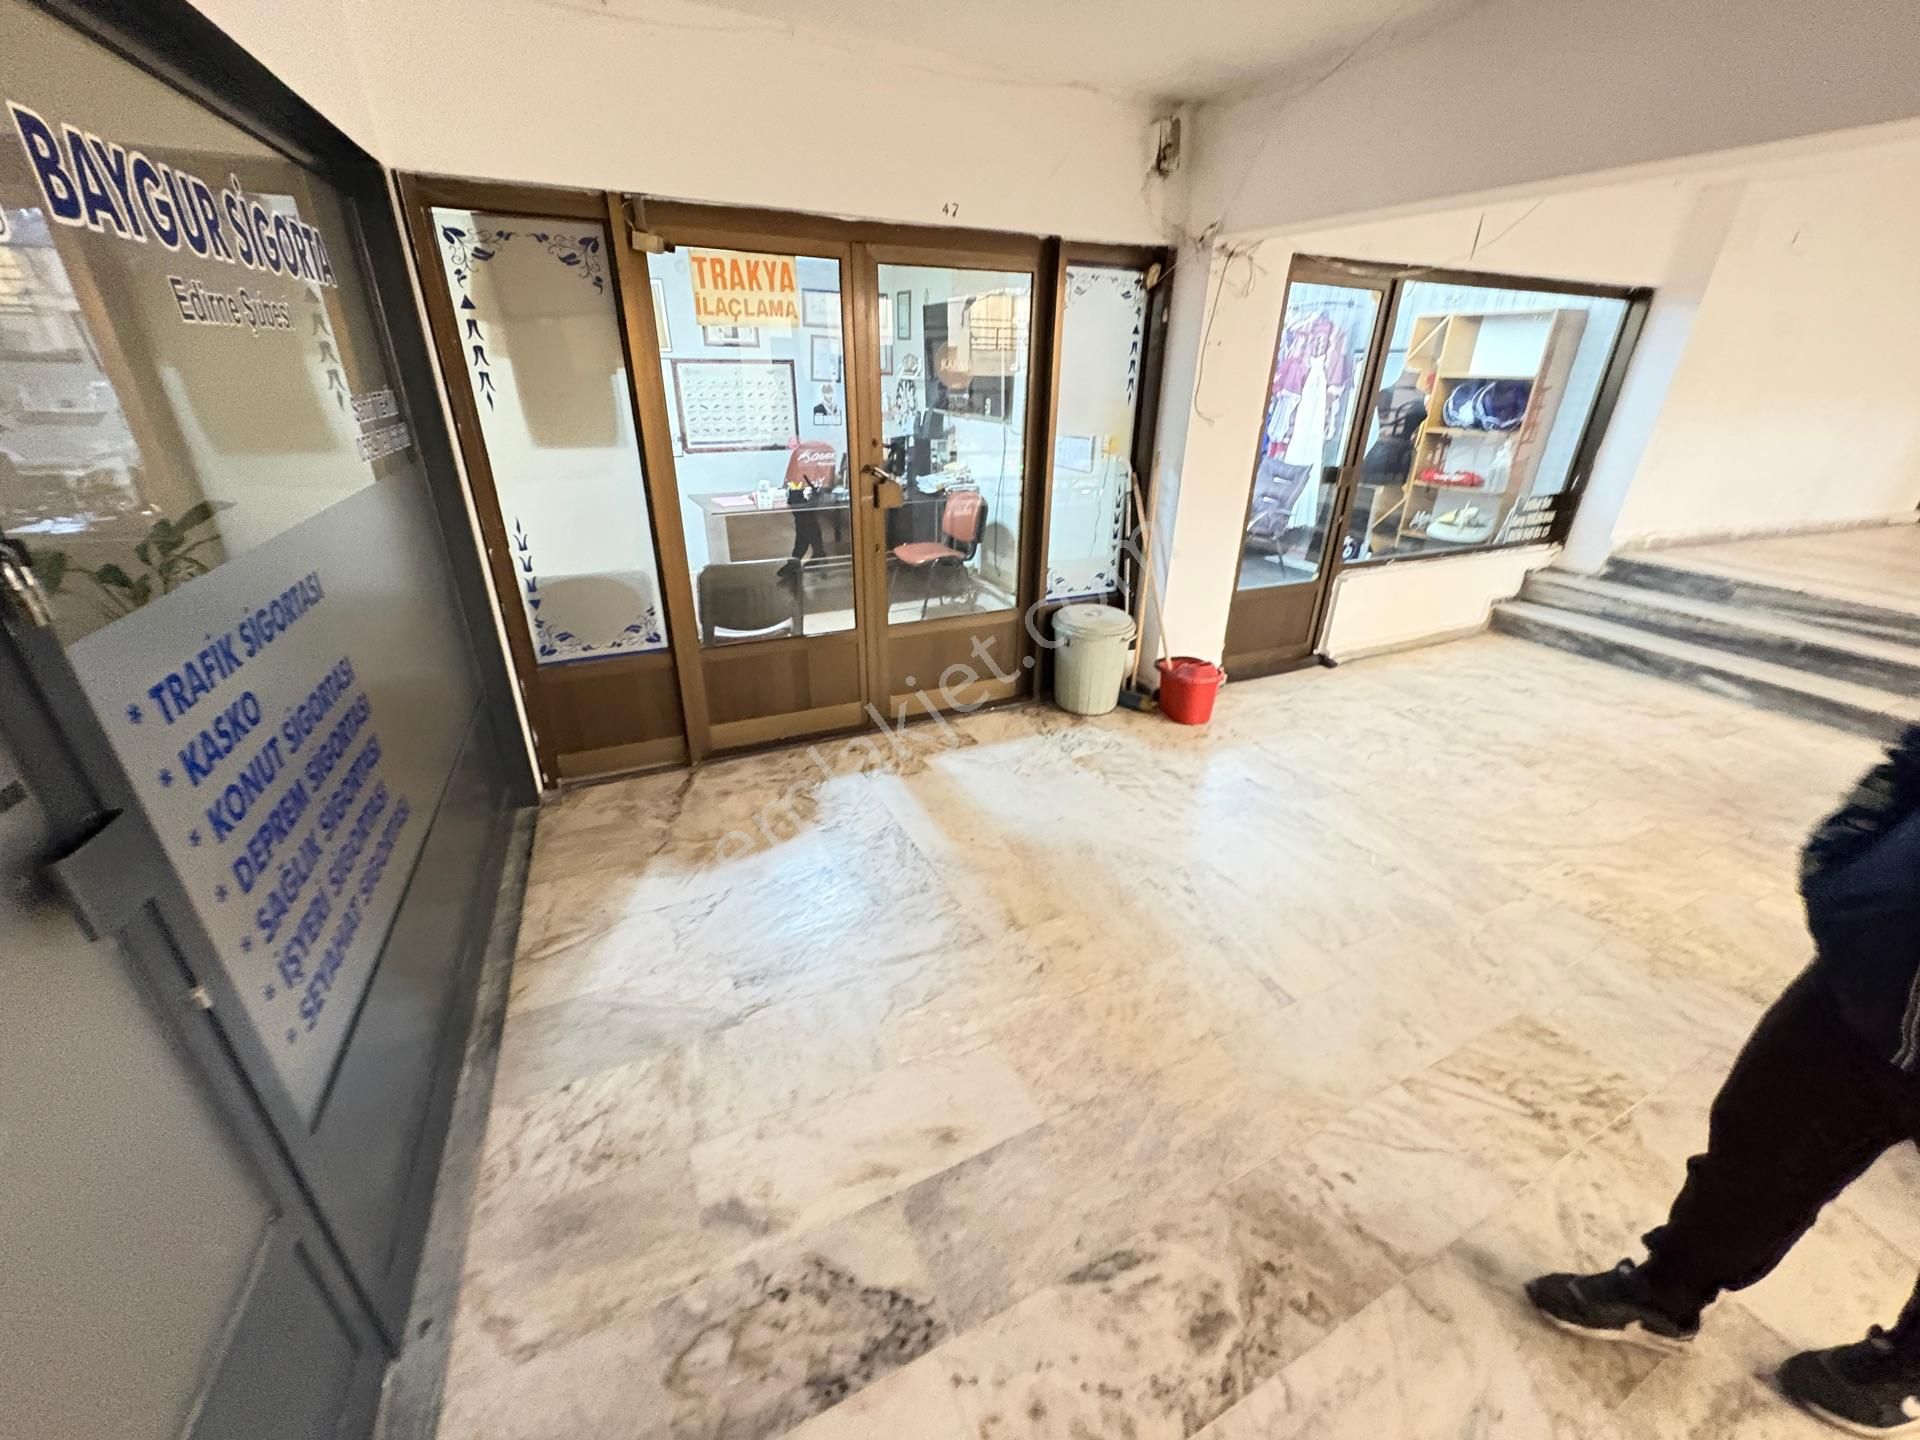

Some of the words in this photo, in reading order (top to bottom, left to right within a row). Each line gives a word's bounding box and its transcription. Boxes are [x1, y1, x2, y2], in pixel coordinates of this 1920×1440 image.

[6, 99, 236, 265] BAYGUR
[222, 172, 338, 289] SİGORTA
[941, 202, 960, 218] 47
[167, 275, 243, 327] Edirne
[690, 255, 796, 293] TRAKYA
[694, 291, 799, 322] İLAÇLAMA
[148, 632, 244, 725] TRAFİK
[180, 690, 262, 788] KASKO
[207, 735, 285, 844] KONUT
[230, 778, 311, 894] DEPREM
